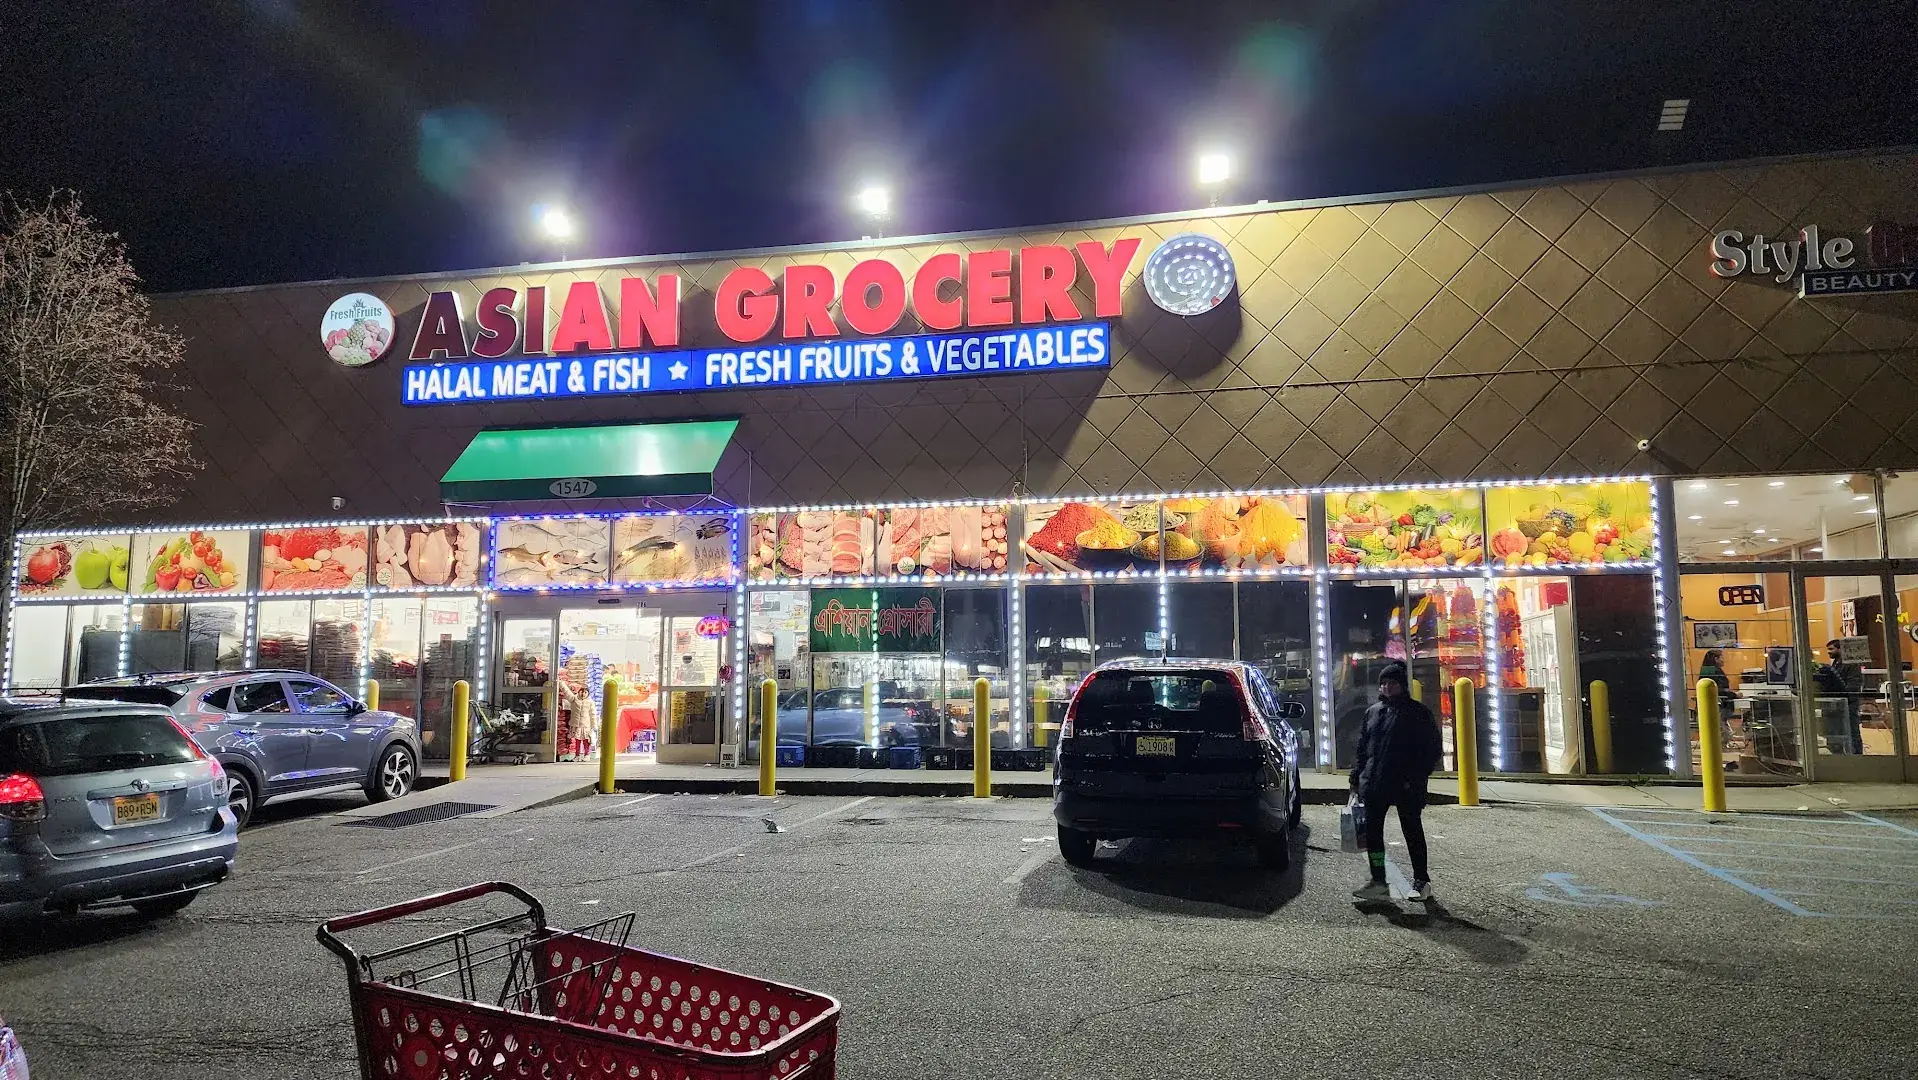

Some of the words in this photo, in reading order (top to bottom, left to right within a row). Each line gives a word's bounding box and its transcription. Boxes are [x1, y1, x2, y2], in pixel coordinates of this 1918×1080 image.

[1710, 224, 1856, 284] Style
[1812, 271, 1916, 292] BEAUTY
[409, 275, 681, 360] ASIAN
[714, 238, 1143, 342] GROCERY
[330, 309, 355, 320] Fresh
[356, 307, 382, 318] Fruits
[407, 366, 485, 401] HALAL
[492, 362, 561, 396] MEAT
[567, 361, 585, 393] &
[594, 357, 651, 391] FISH
[705, 346, 791, 386] FRESH
[799, 342, 892, 381] FRUITS
[900, 342, 919, 374] &
[927, 327, 1105, 373] VEGETABLES
[556, 481, 590, 495] 1547
[1720, 587, 1764, 605] OPEN
[697, 619, 729, 635] OPEN
[1148, 741, 1168, 752] 1908
